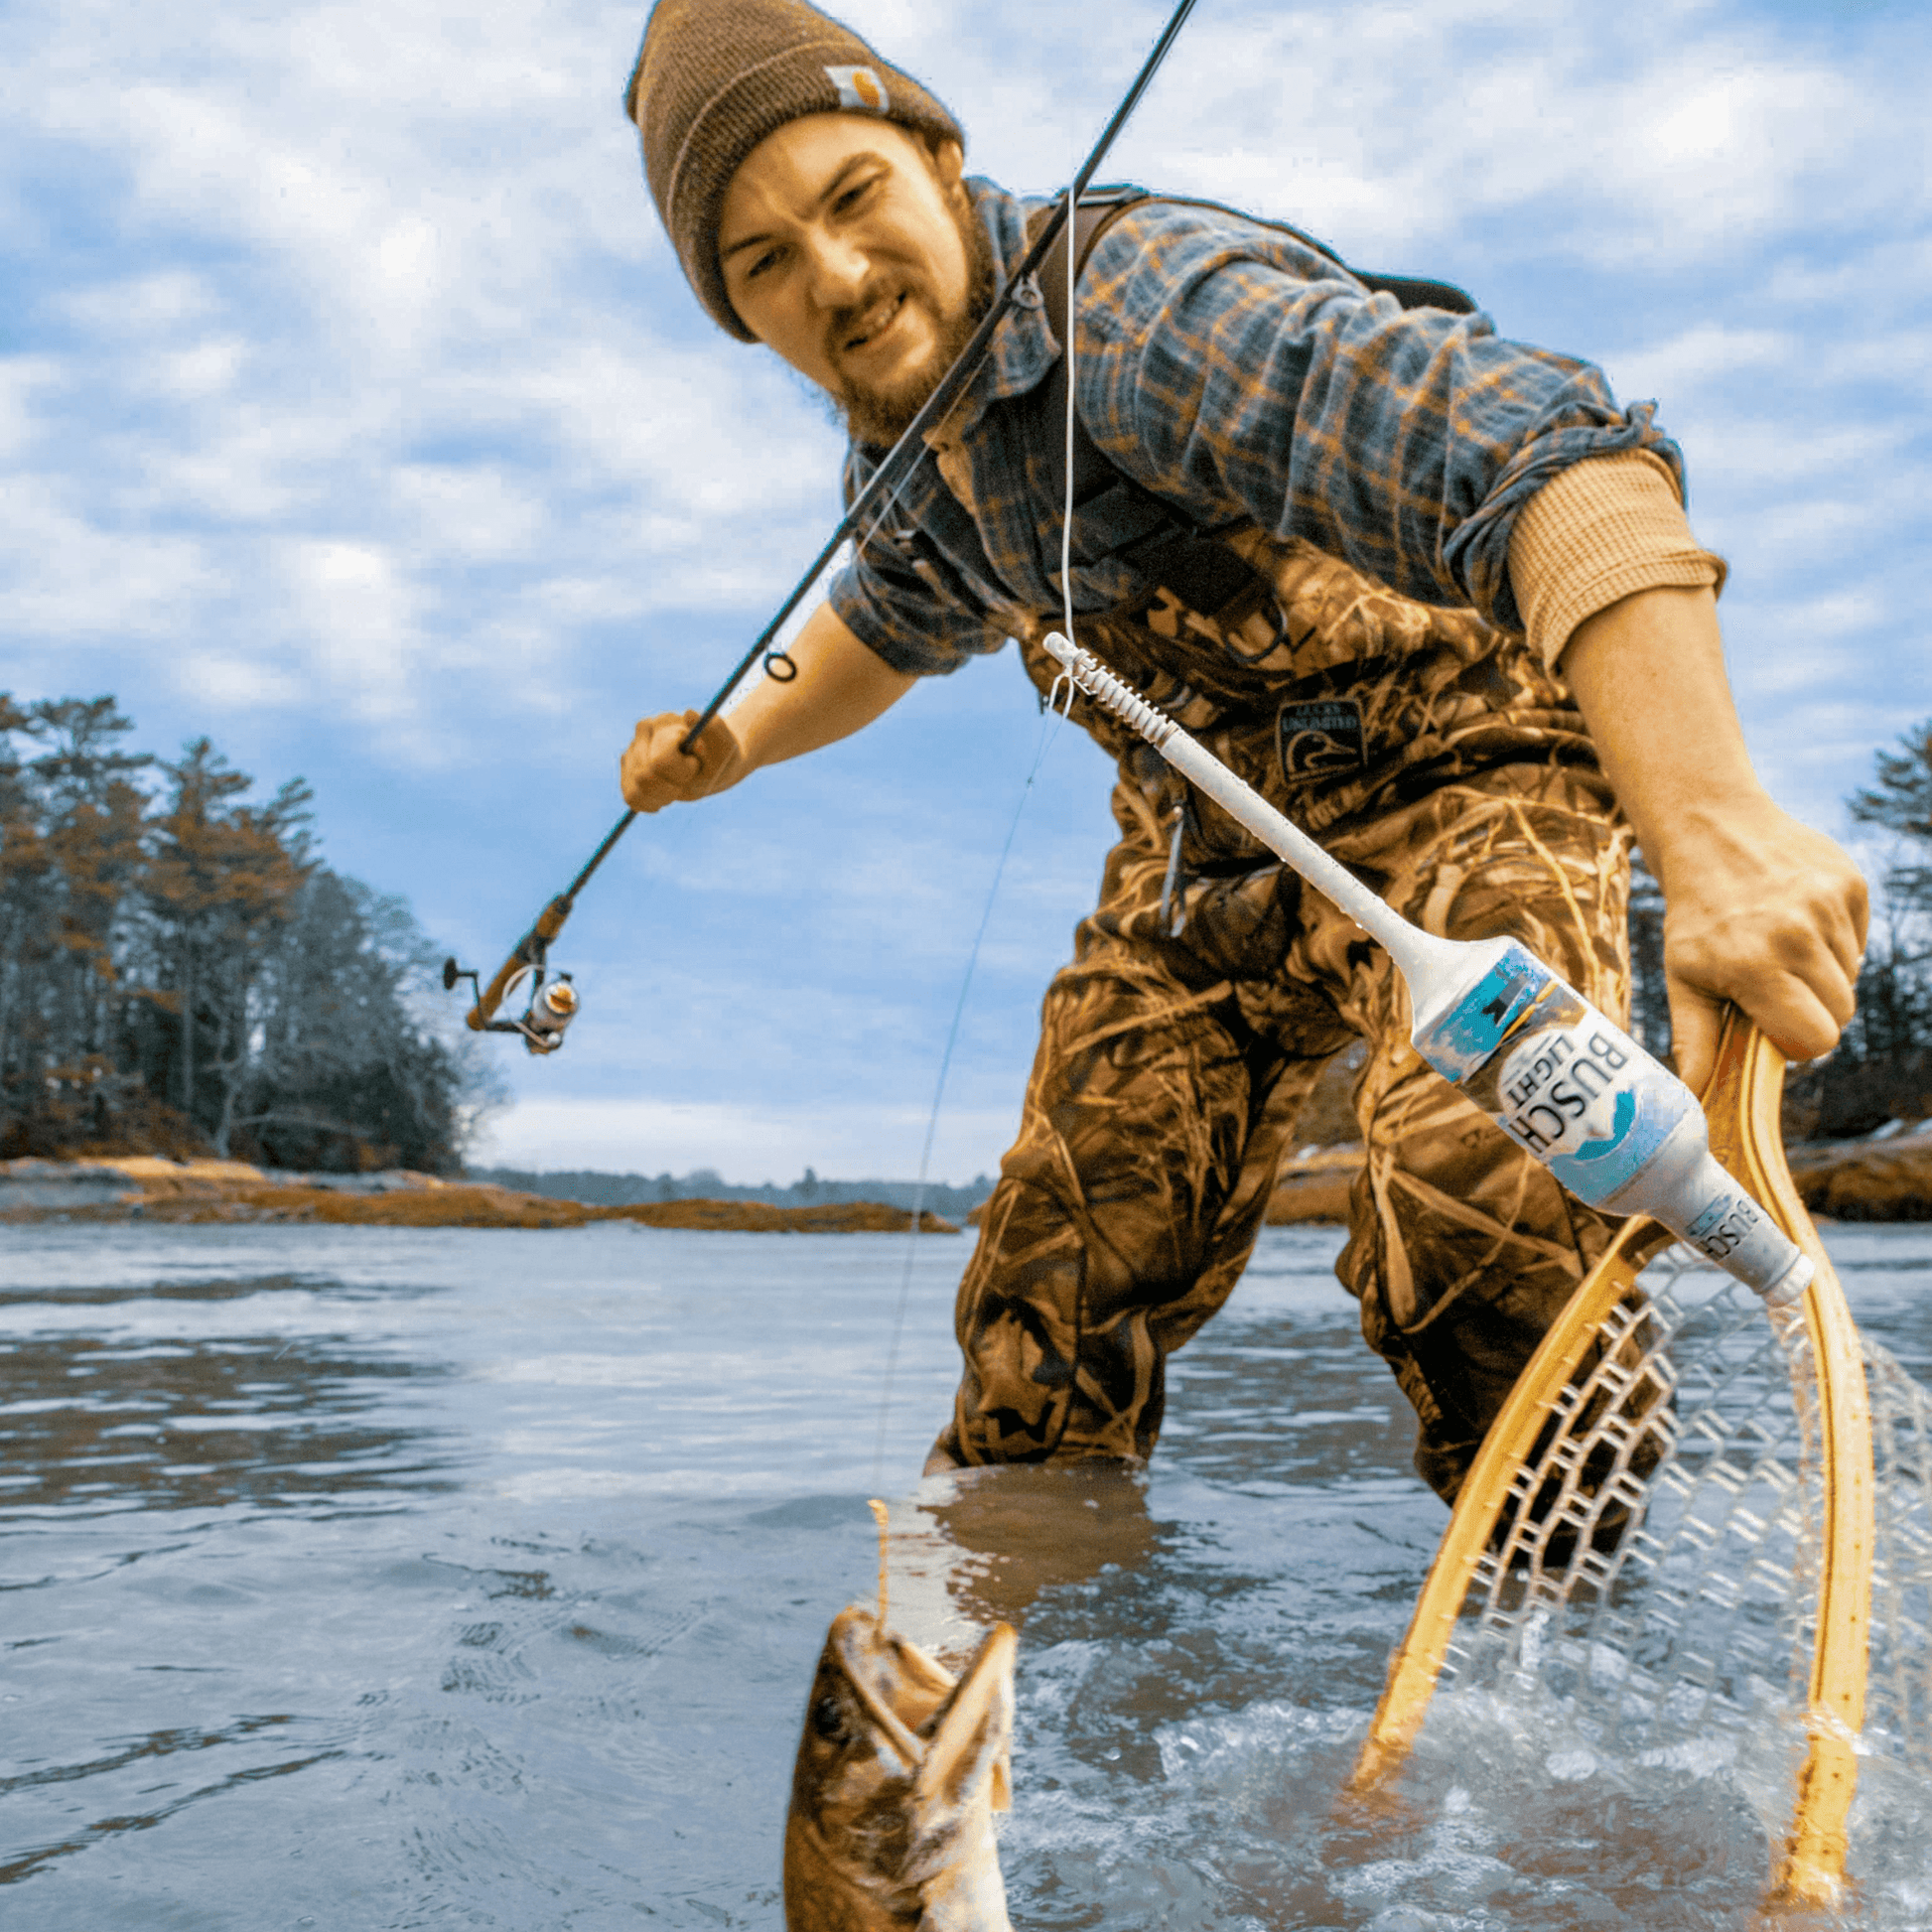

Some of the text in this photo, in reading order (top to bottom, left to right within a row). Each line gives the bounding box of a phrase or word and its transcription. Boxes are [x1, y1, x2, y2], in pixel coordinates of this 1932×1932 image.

[1507, 1034, 1575, 1109] LIGHT
[1508, 1032, 1628, 1154] BUSCH
[1695, 1198, 1759, 1262] BUSCH
